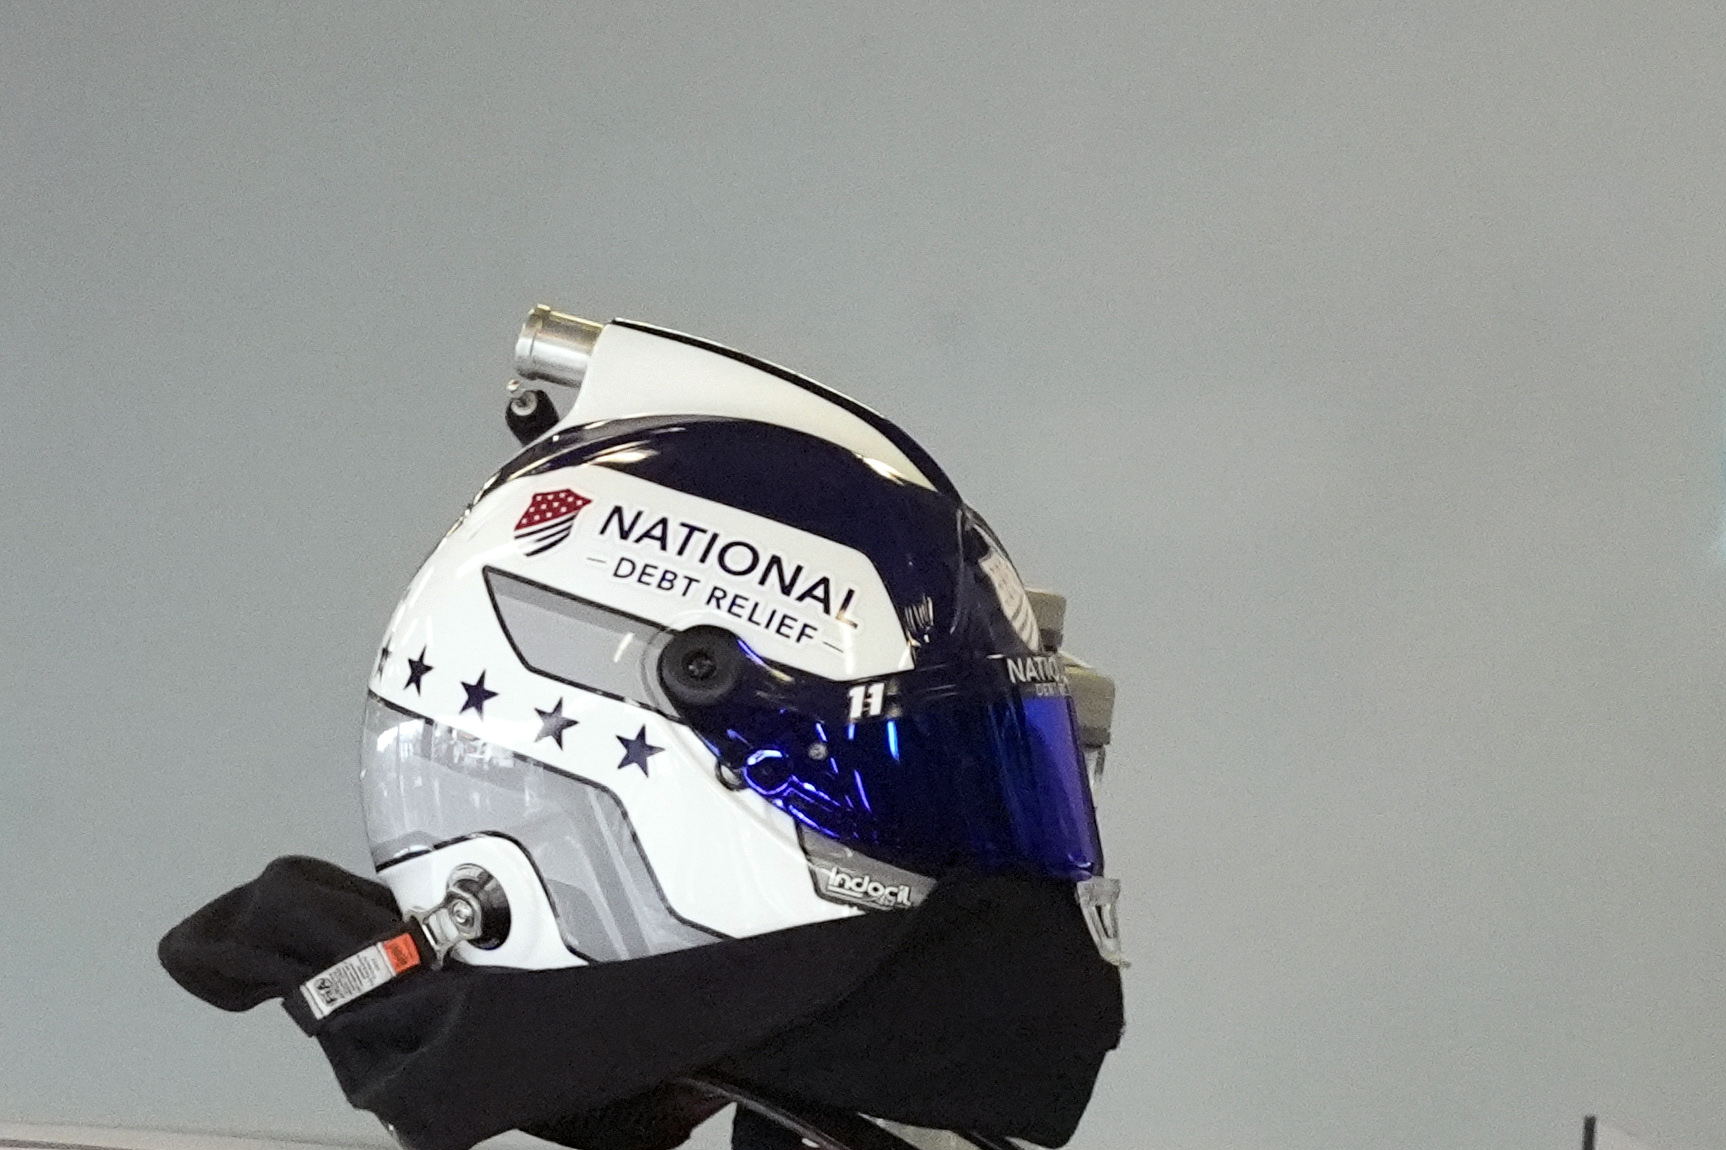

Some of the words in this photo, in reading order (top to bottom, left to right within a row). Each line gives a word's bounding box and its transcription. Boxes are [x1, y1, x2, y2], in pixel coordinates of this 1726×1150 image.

[599, 505, 859, 629] NATIONAL
[613, 557, 700, 597] DEBT
[706, 586, 818, 643] RELIEF
[848, 683, 886, 718] 11
